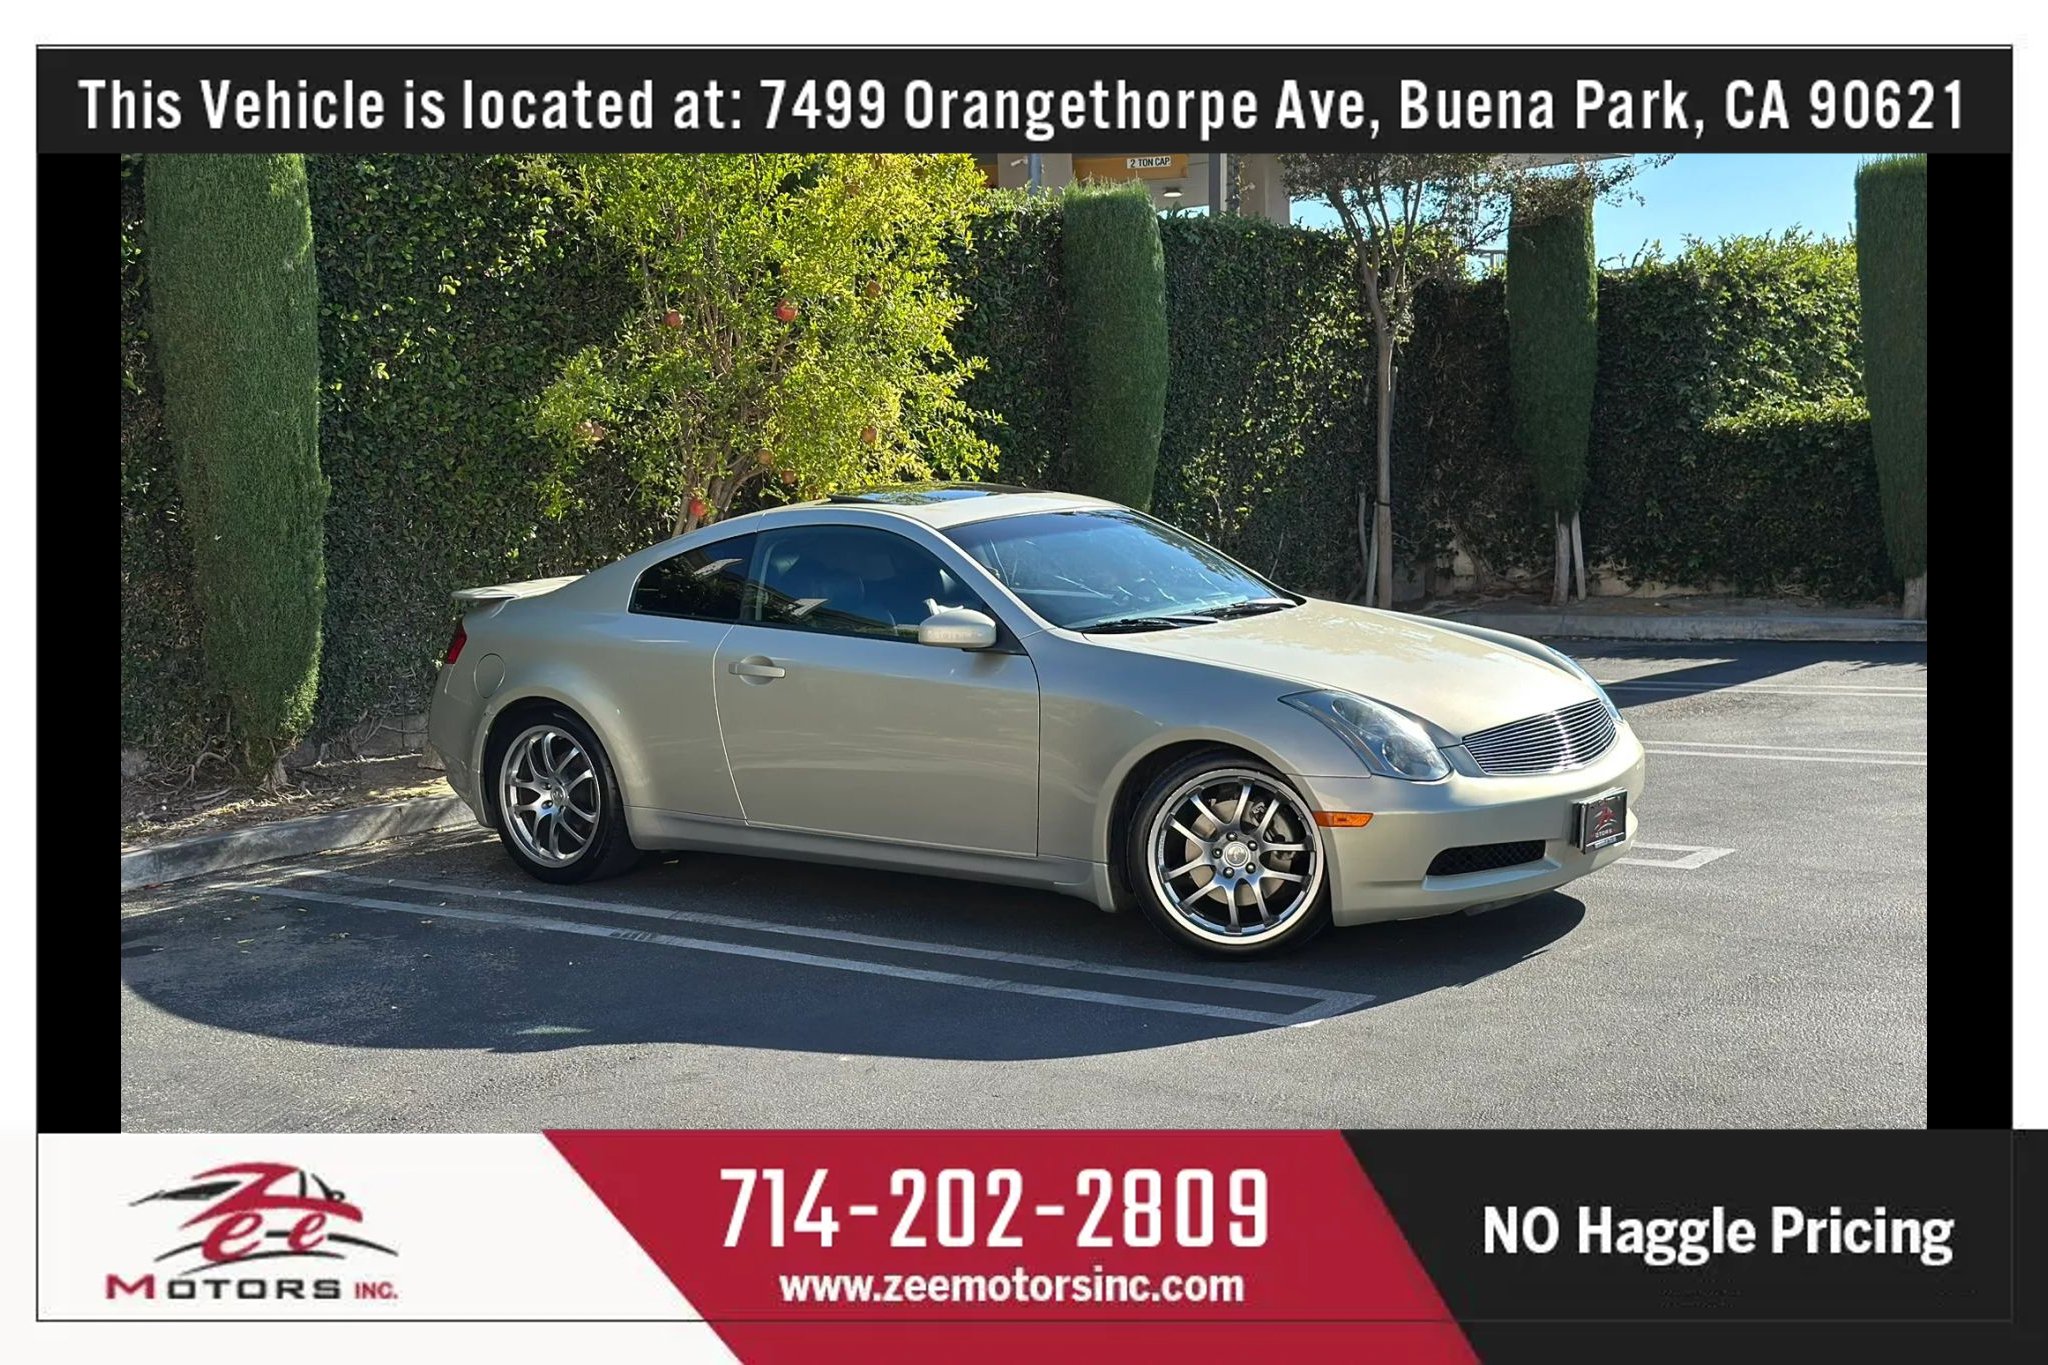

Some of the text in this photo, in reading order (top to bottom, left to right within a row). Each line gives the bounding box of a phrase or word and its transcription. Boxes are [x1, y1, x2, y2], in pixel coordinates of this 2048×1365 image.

[1130, 156, 1170, 168] 2 TON CAP
